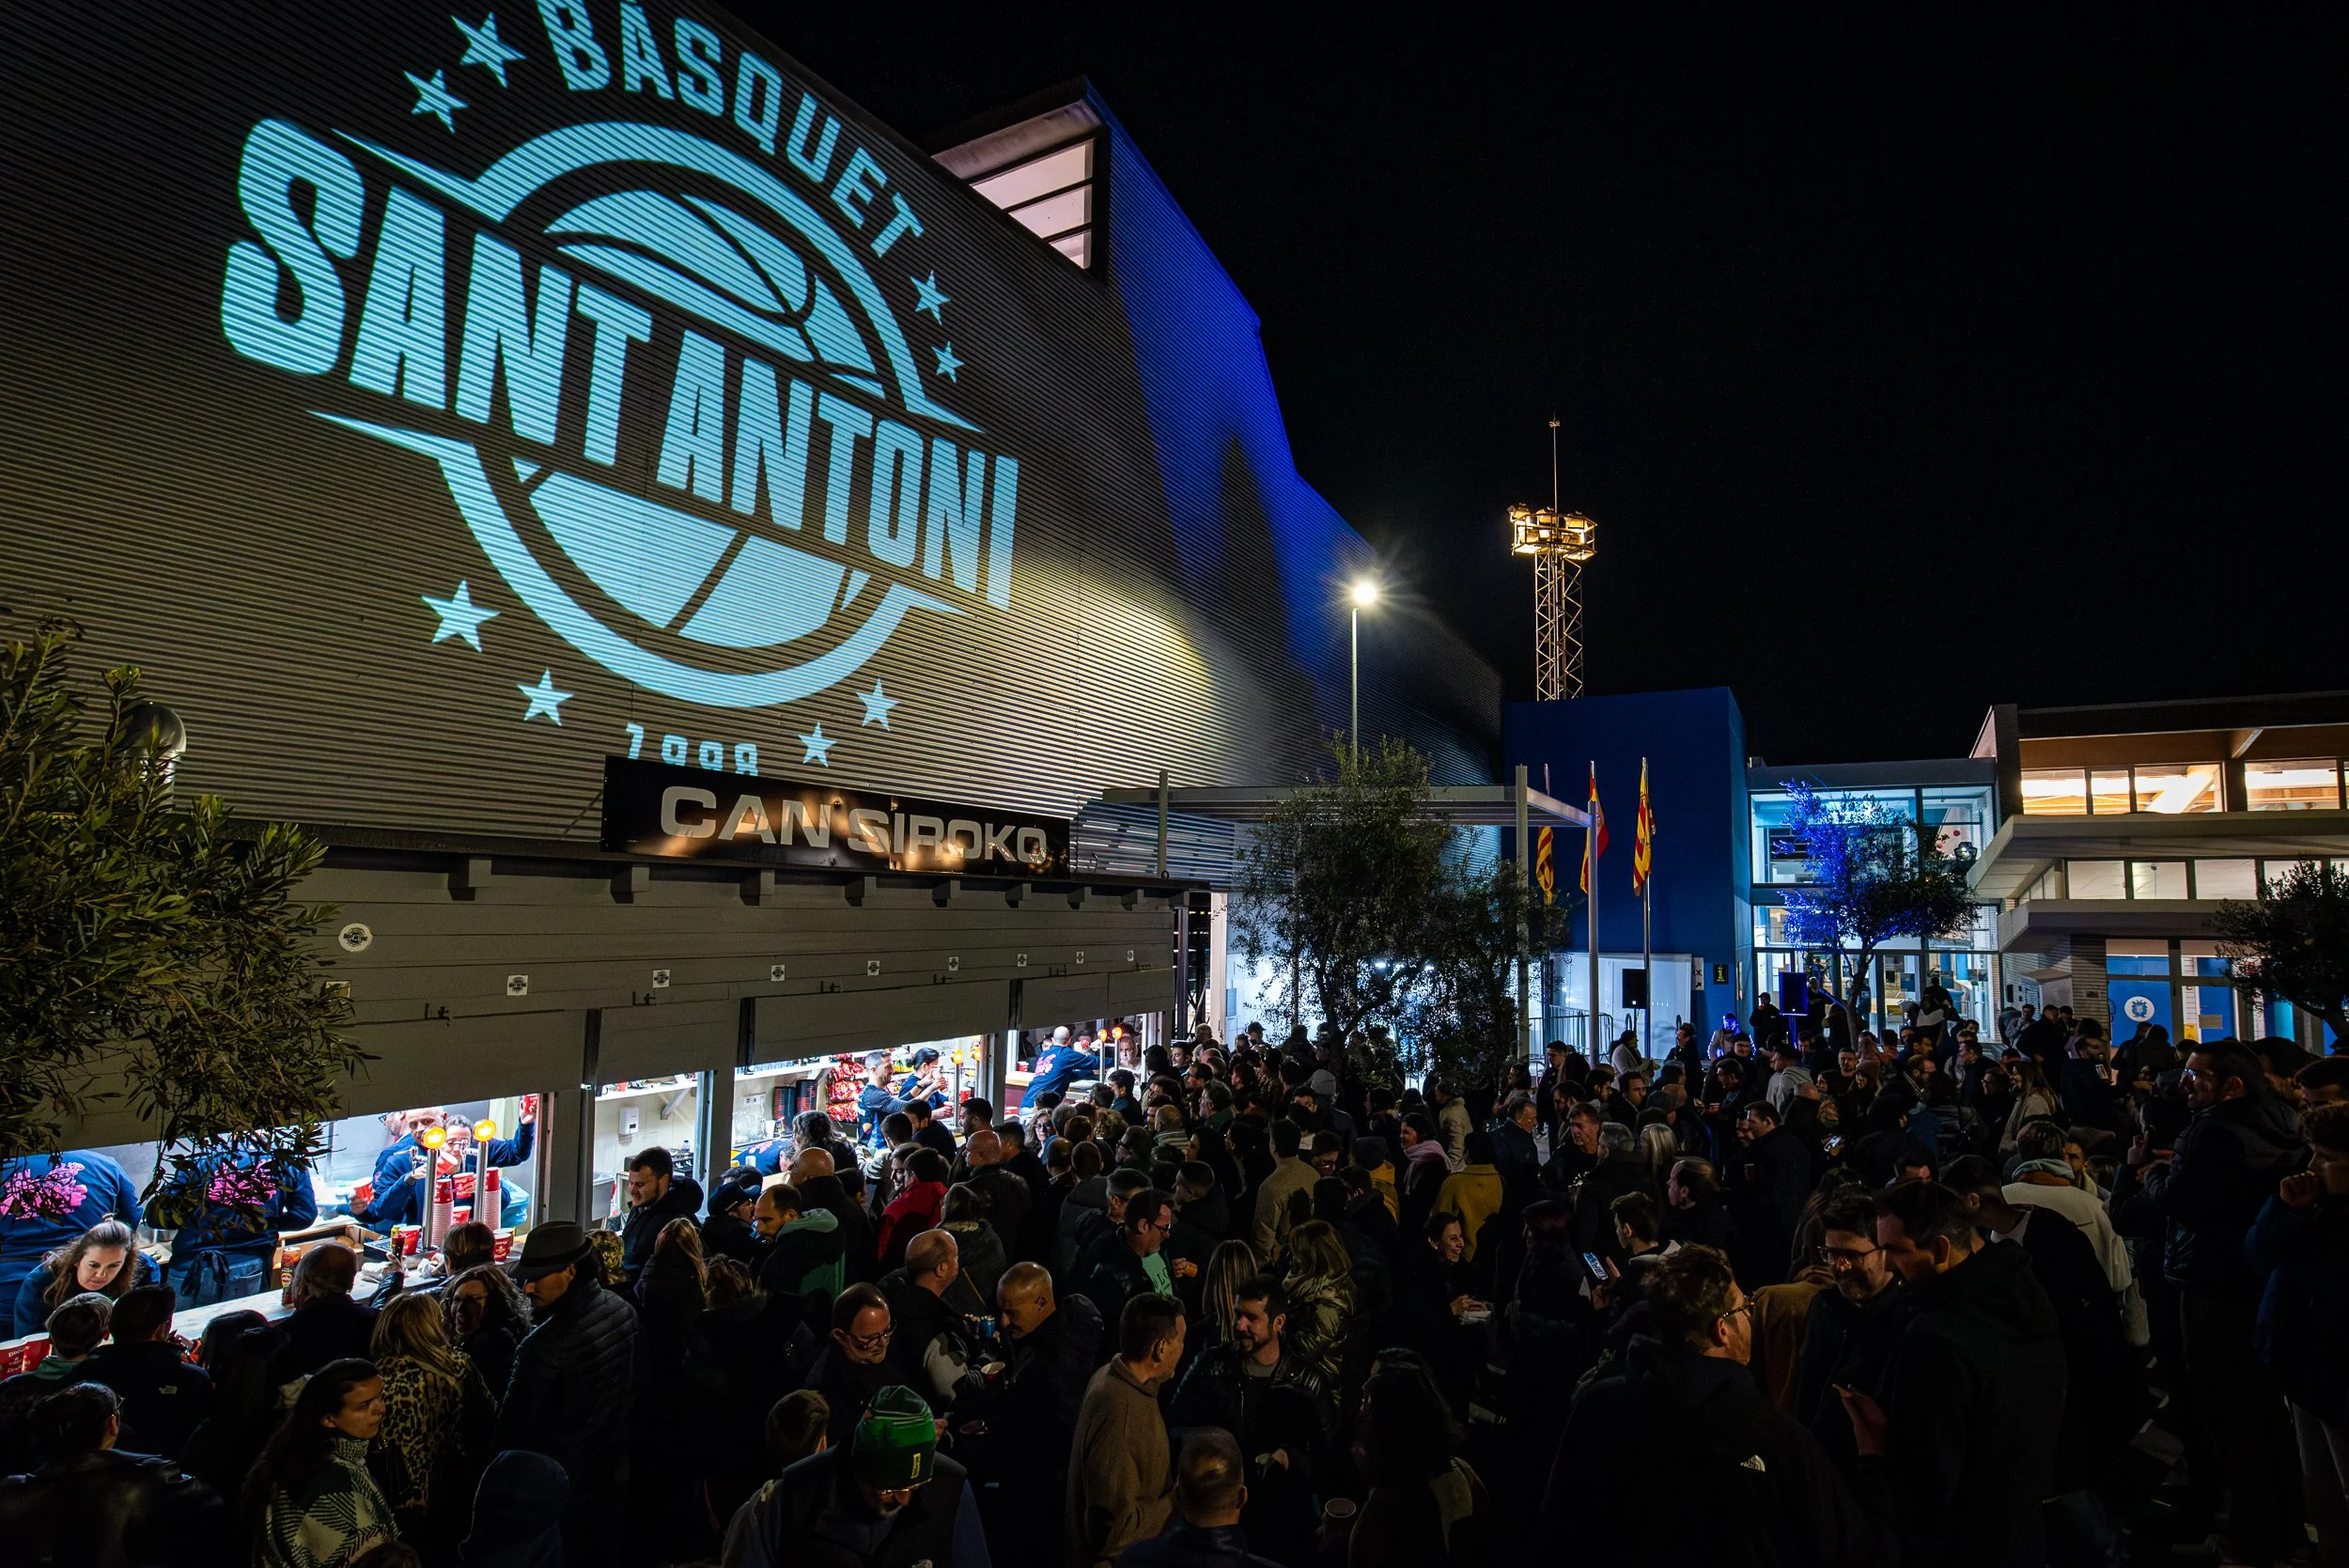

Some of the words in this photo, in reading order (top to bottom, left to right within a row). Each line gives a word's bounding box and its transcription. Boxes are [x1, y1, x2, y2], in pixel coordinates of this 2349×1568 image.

[221, 118, 652, 468] SANT
[657, 329, 1019, 611] ANTONI
[625, 722, 759, 777] 1998
[660, 785, 832, 848] CAN
[848, 808, 1048, 864] SIROKO
